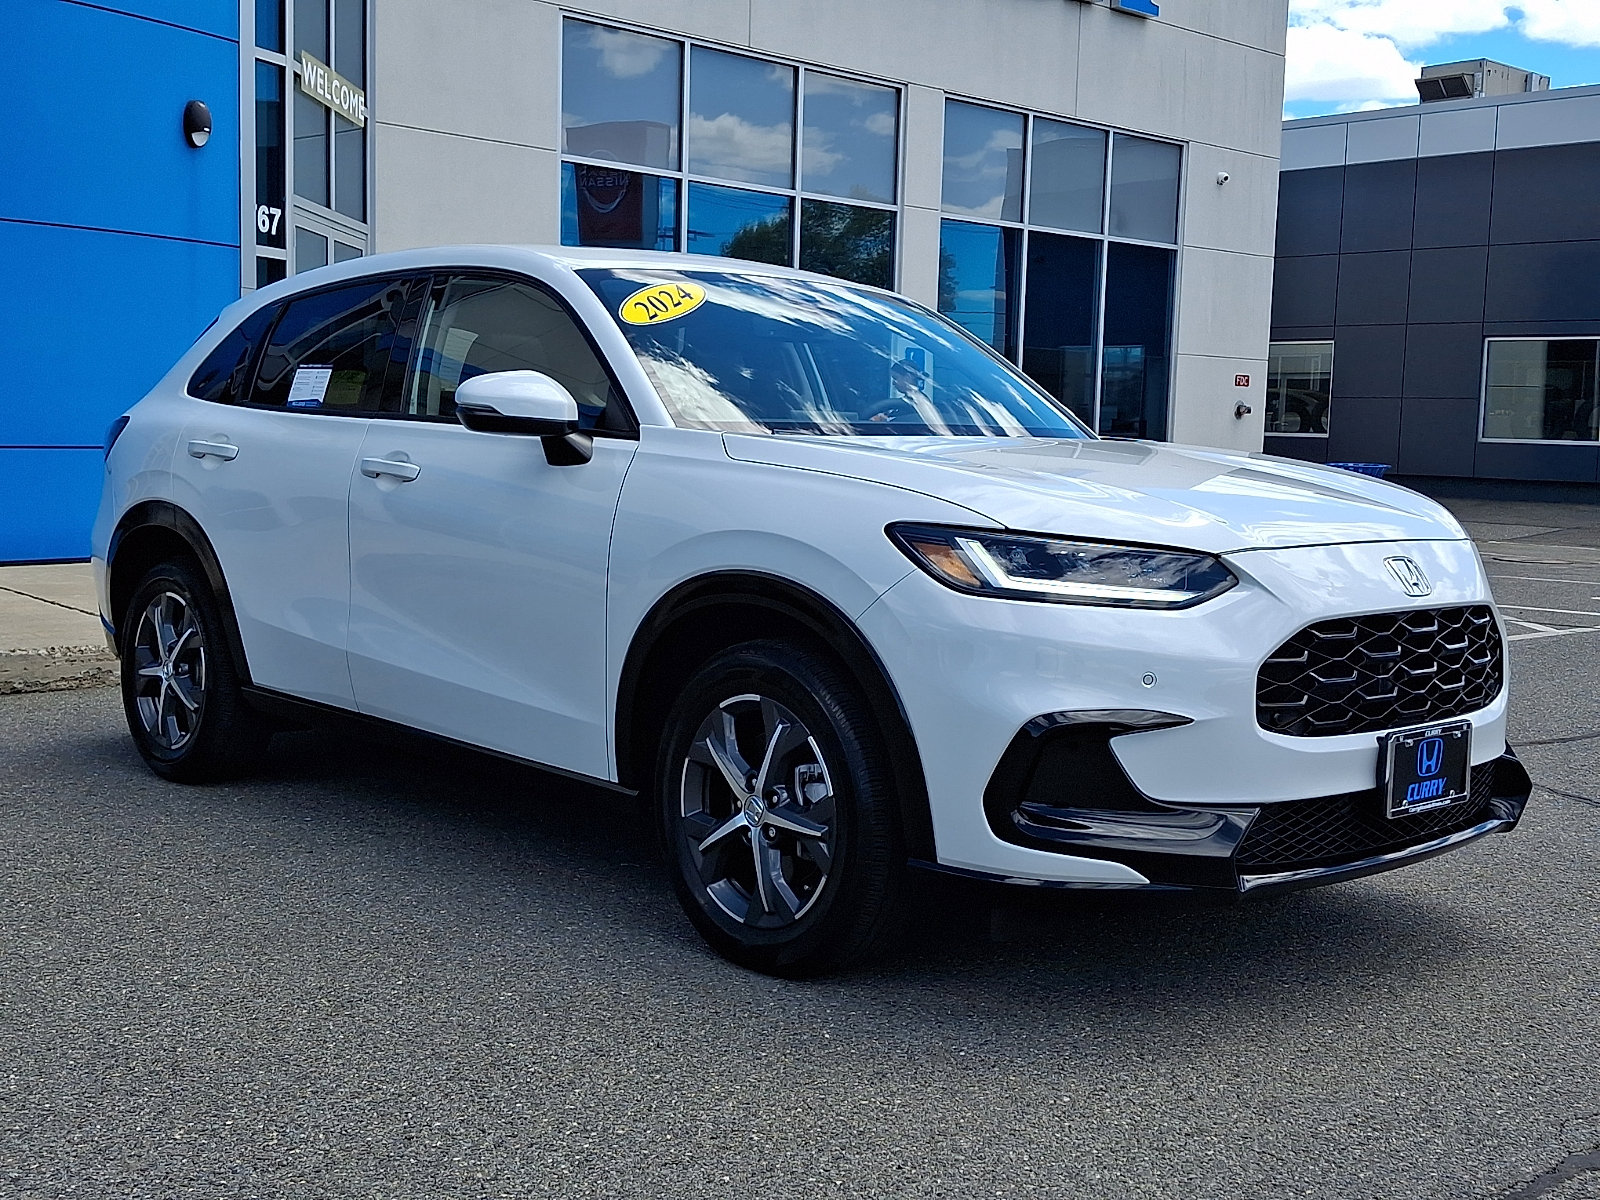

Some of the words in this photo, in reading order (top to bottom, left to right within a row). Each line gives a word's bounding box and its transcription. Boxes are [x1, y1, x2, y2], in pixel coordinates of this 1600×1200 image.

[302, 57, 365, 121] WELCOME
[633, 284, 694, 321] 2024
[1236, 375, 1249, 386] FDC
[1407, 777, 1447, 801] CURRY
